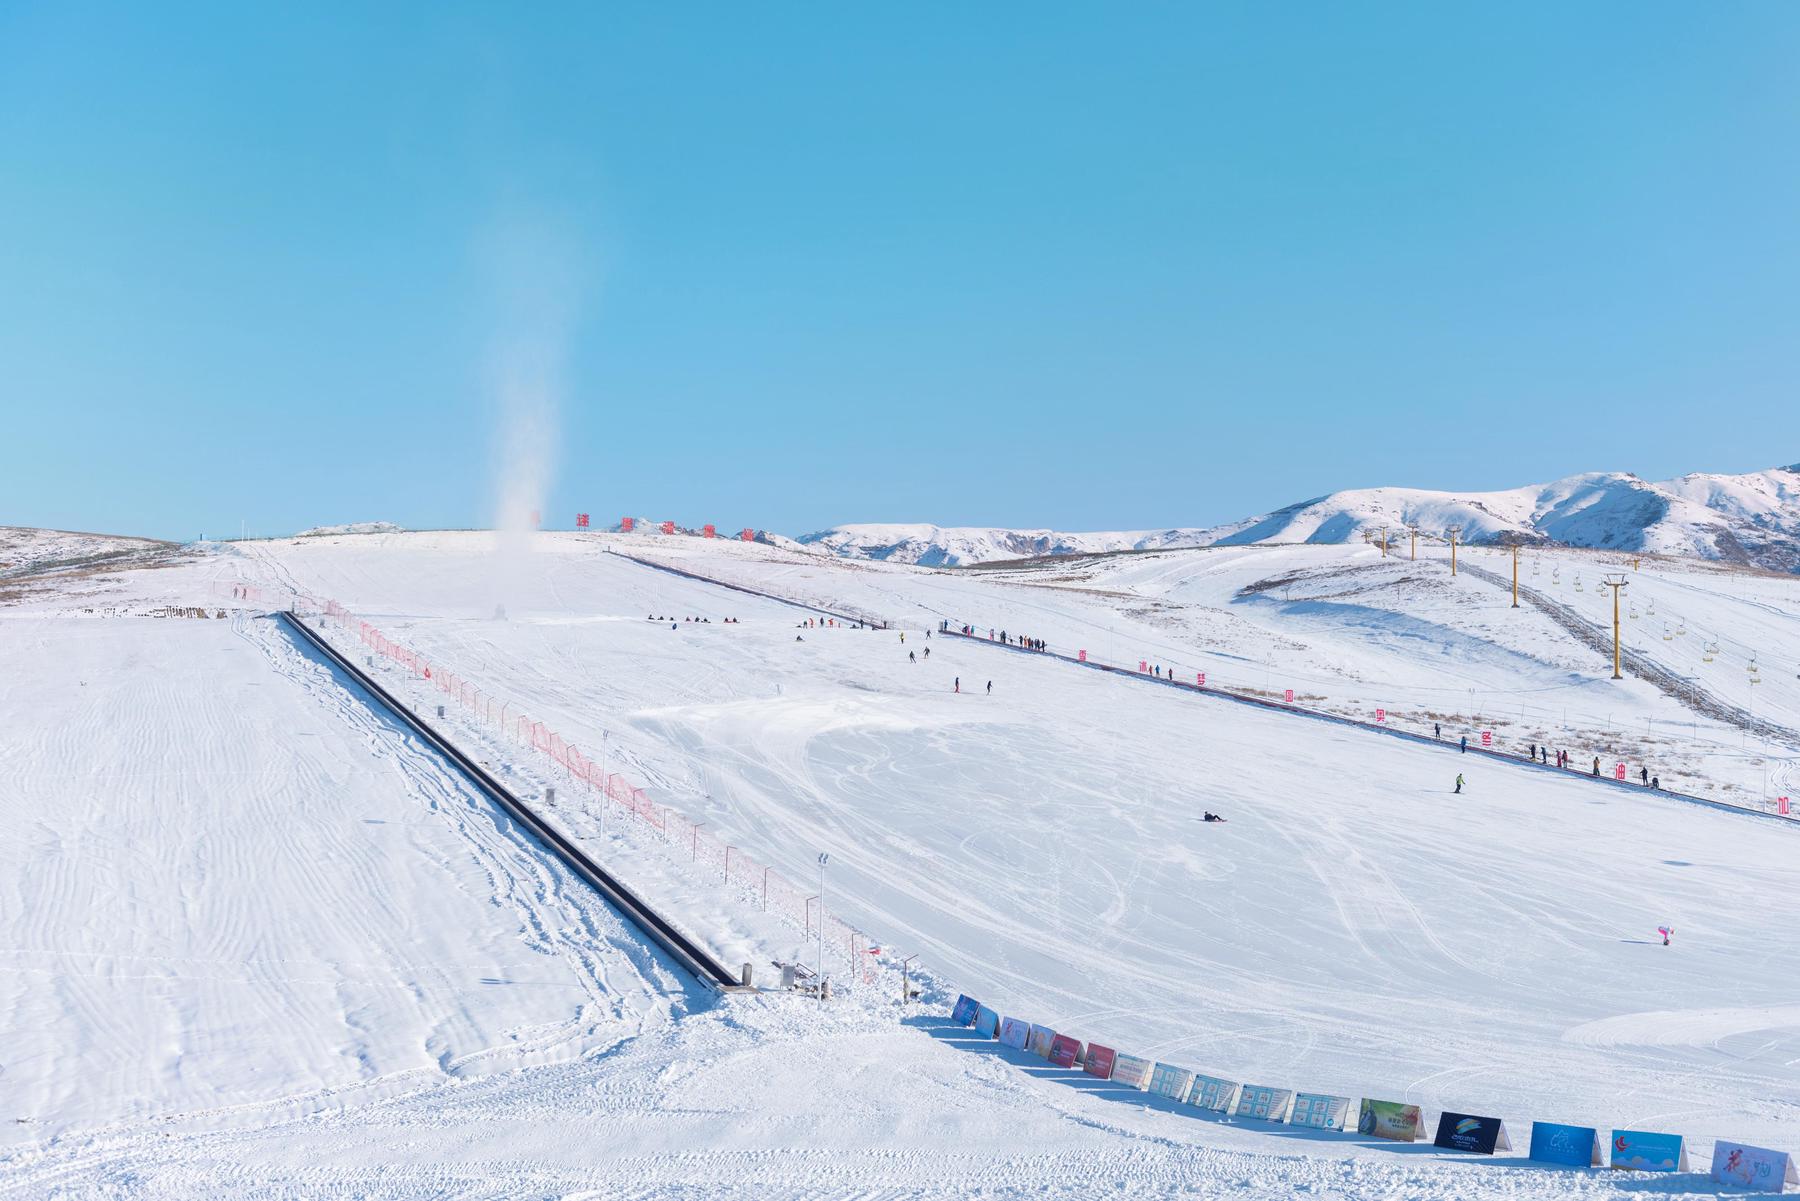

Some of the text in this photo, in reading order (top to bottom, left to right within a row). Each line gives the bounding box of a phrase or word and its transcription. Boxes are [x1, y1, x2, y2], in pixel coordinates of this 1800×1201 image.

[1481, 731, 1492, 746] 冬
[1615, 763, 1626, 780] 油
[1777, 796, 1790, 815] 加
